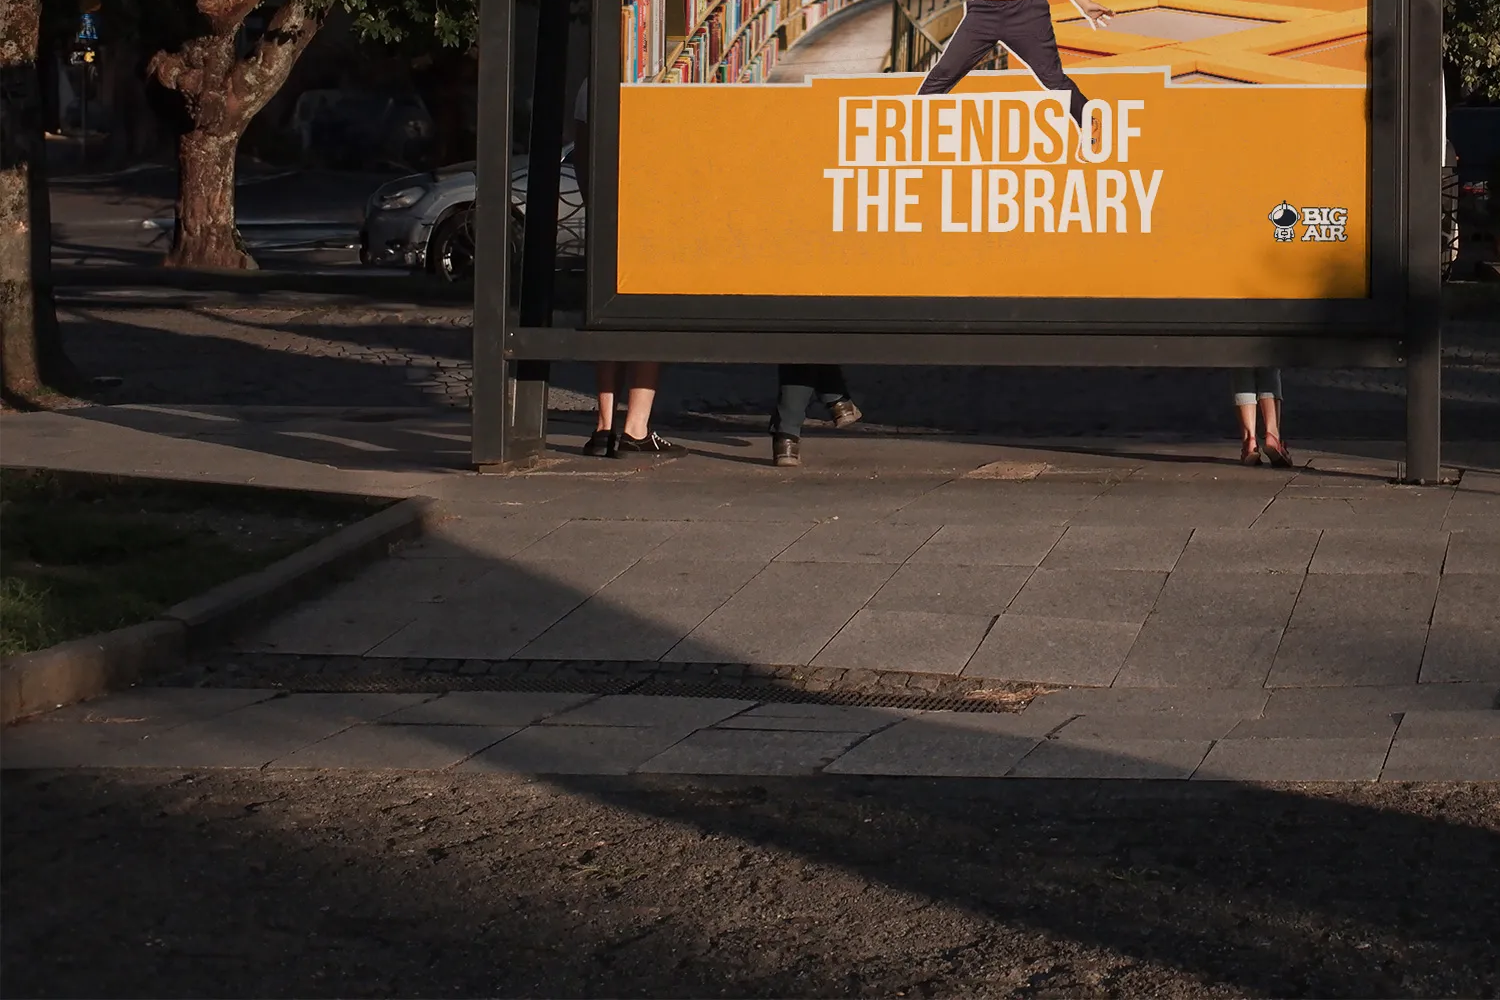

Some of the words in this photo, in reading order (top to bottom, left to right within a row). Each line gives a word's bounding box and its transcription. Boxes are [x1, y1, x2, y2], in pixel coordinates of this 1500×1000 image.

[845, 99, 1064, 164] FRIENDS
[1081, 98, 1145, 163] OF
[823, 168, 923, 233] THE
[942, 168, 1164, 234] LIBRARY
[1301, 207, 1349, 226] BIG
[1301, 224, 1349, 242] AIR
